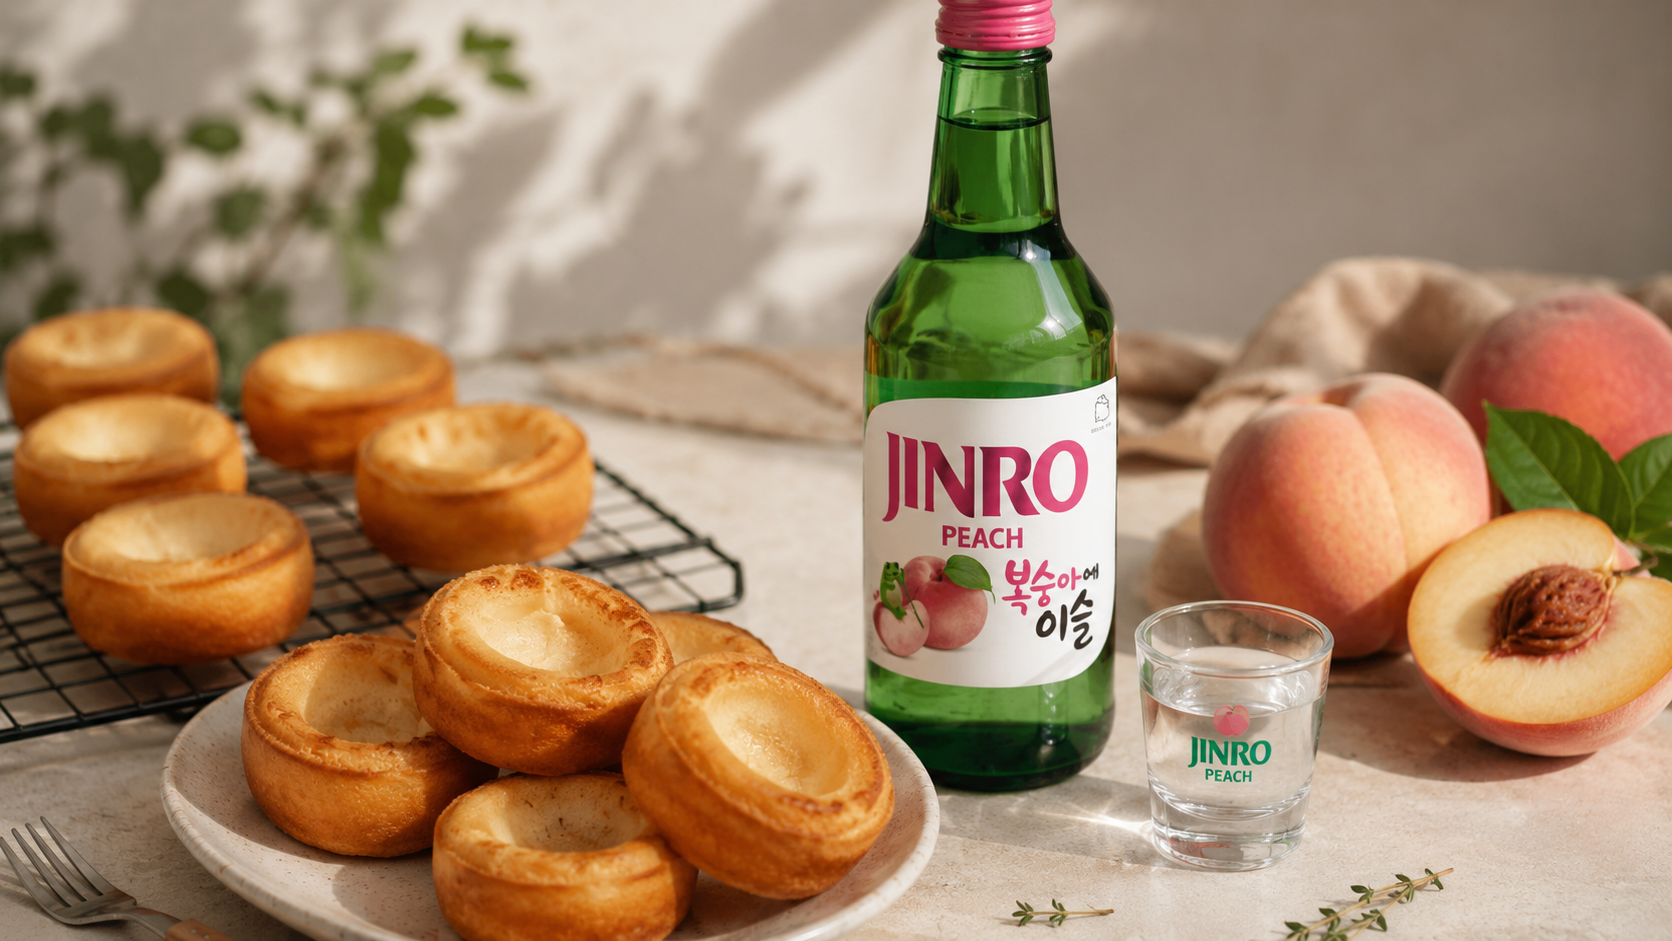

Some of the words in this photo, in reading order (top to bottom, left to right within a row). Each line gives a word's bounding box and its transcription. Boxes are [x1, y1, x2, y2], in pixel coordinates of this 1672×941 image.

[882, 431, 1089, 522] JINRO
[942, 525, 1023, 549] PEACH
[1002, 559, 1099, 616] 복숭아에
[1035, 589, 1094, 650] 이슬
[1188, 736, 1272, 768] JINRO
[1205, 768, 1252, 783] PEACH
